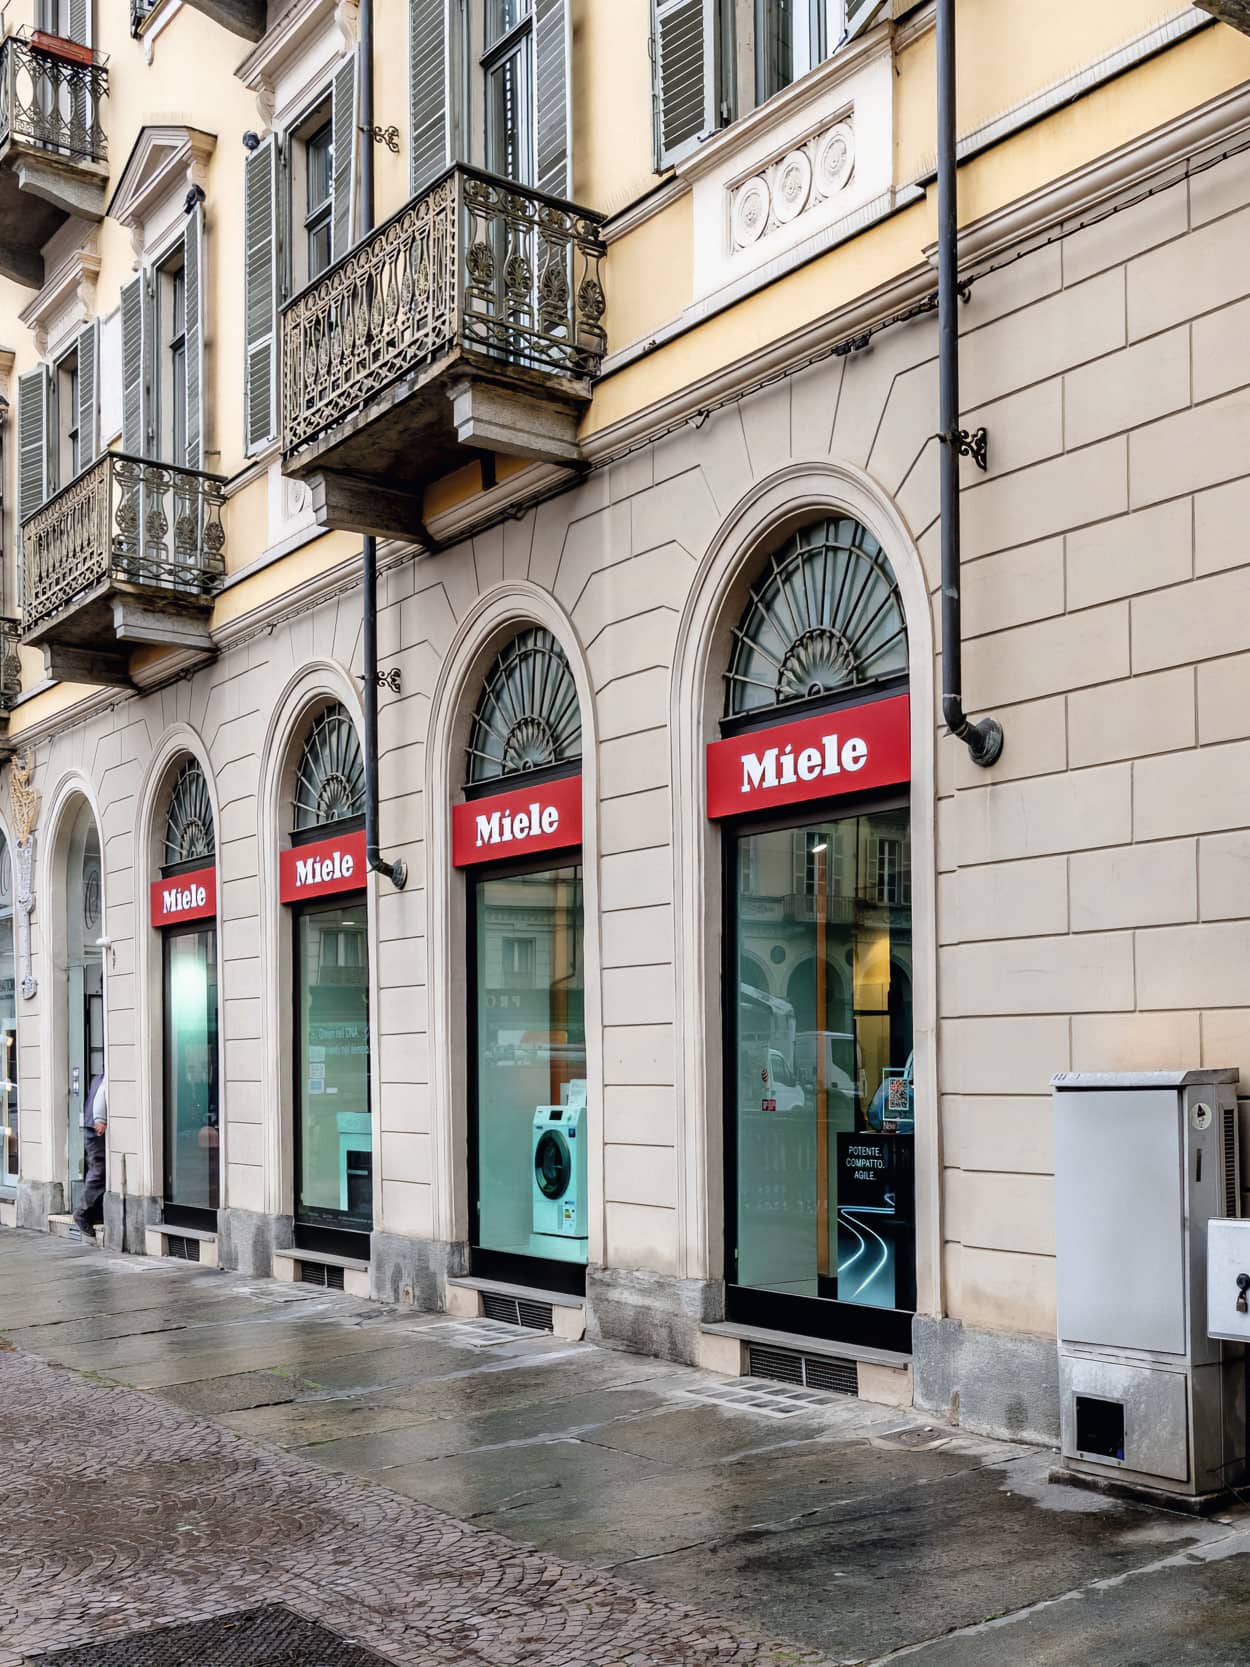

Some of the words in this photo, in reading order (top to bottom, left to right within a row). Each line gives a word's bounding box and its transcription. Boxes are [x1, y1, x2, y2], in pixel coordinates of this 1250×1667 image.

[741, 733, 868, 793] Miele
[475, 801, 559, 847] Miele
[296, 852, 354, 887] Miele
[162, 884, 206, 914] Miele
[846, 1158, 885, 1169] COMPATTO.
[848, 1146, 882, 1157] POTENTE.
[854, 1171, 877, 1180] AGILE.
